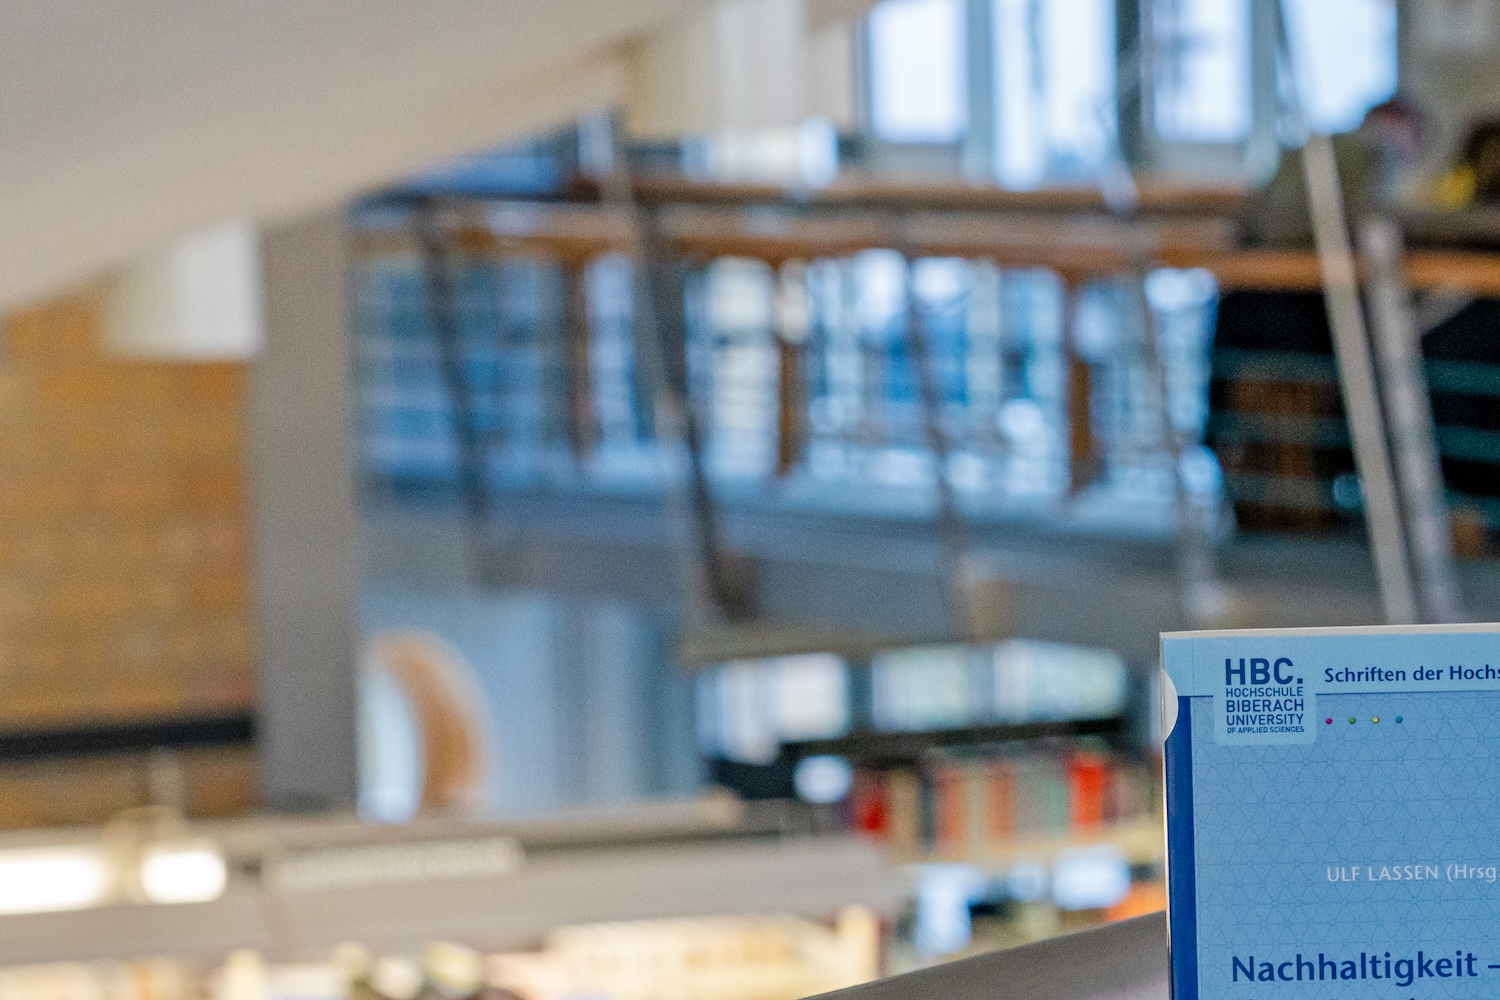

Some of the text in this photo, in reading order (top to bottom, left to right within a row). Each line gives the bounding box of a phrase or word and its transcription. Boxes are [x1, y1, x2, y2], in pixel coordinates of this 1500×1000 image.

[1225, 657, 1304, 686] HBC.
[1324, 667, 1407, 683] Schriften
[1413, 665, 1444, 681] der
[1225, 686, 1304, 698] HOCHSCHULE
[1226, 699, 1304, 713] BIBERACH
[1226, 714, 1304, 726] UNIVERSITY
[1327, 866, 1361, 882] ULF
[1368, 865, 1439, 882] LASSEN
[1231, 950, 1478, 987] Nachhaltigkeit
